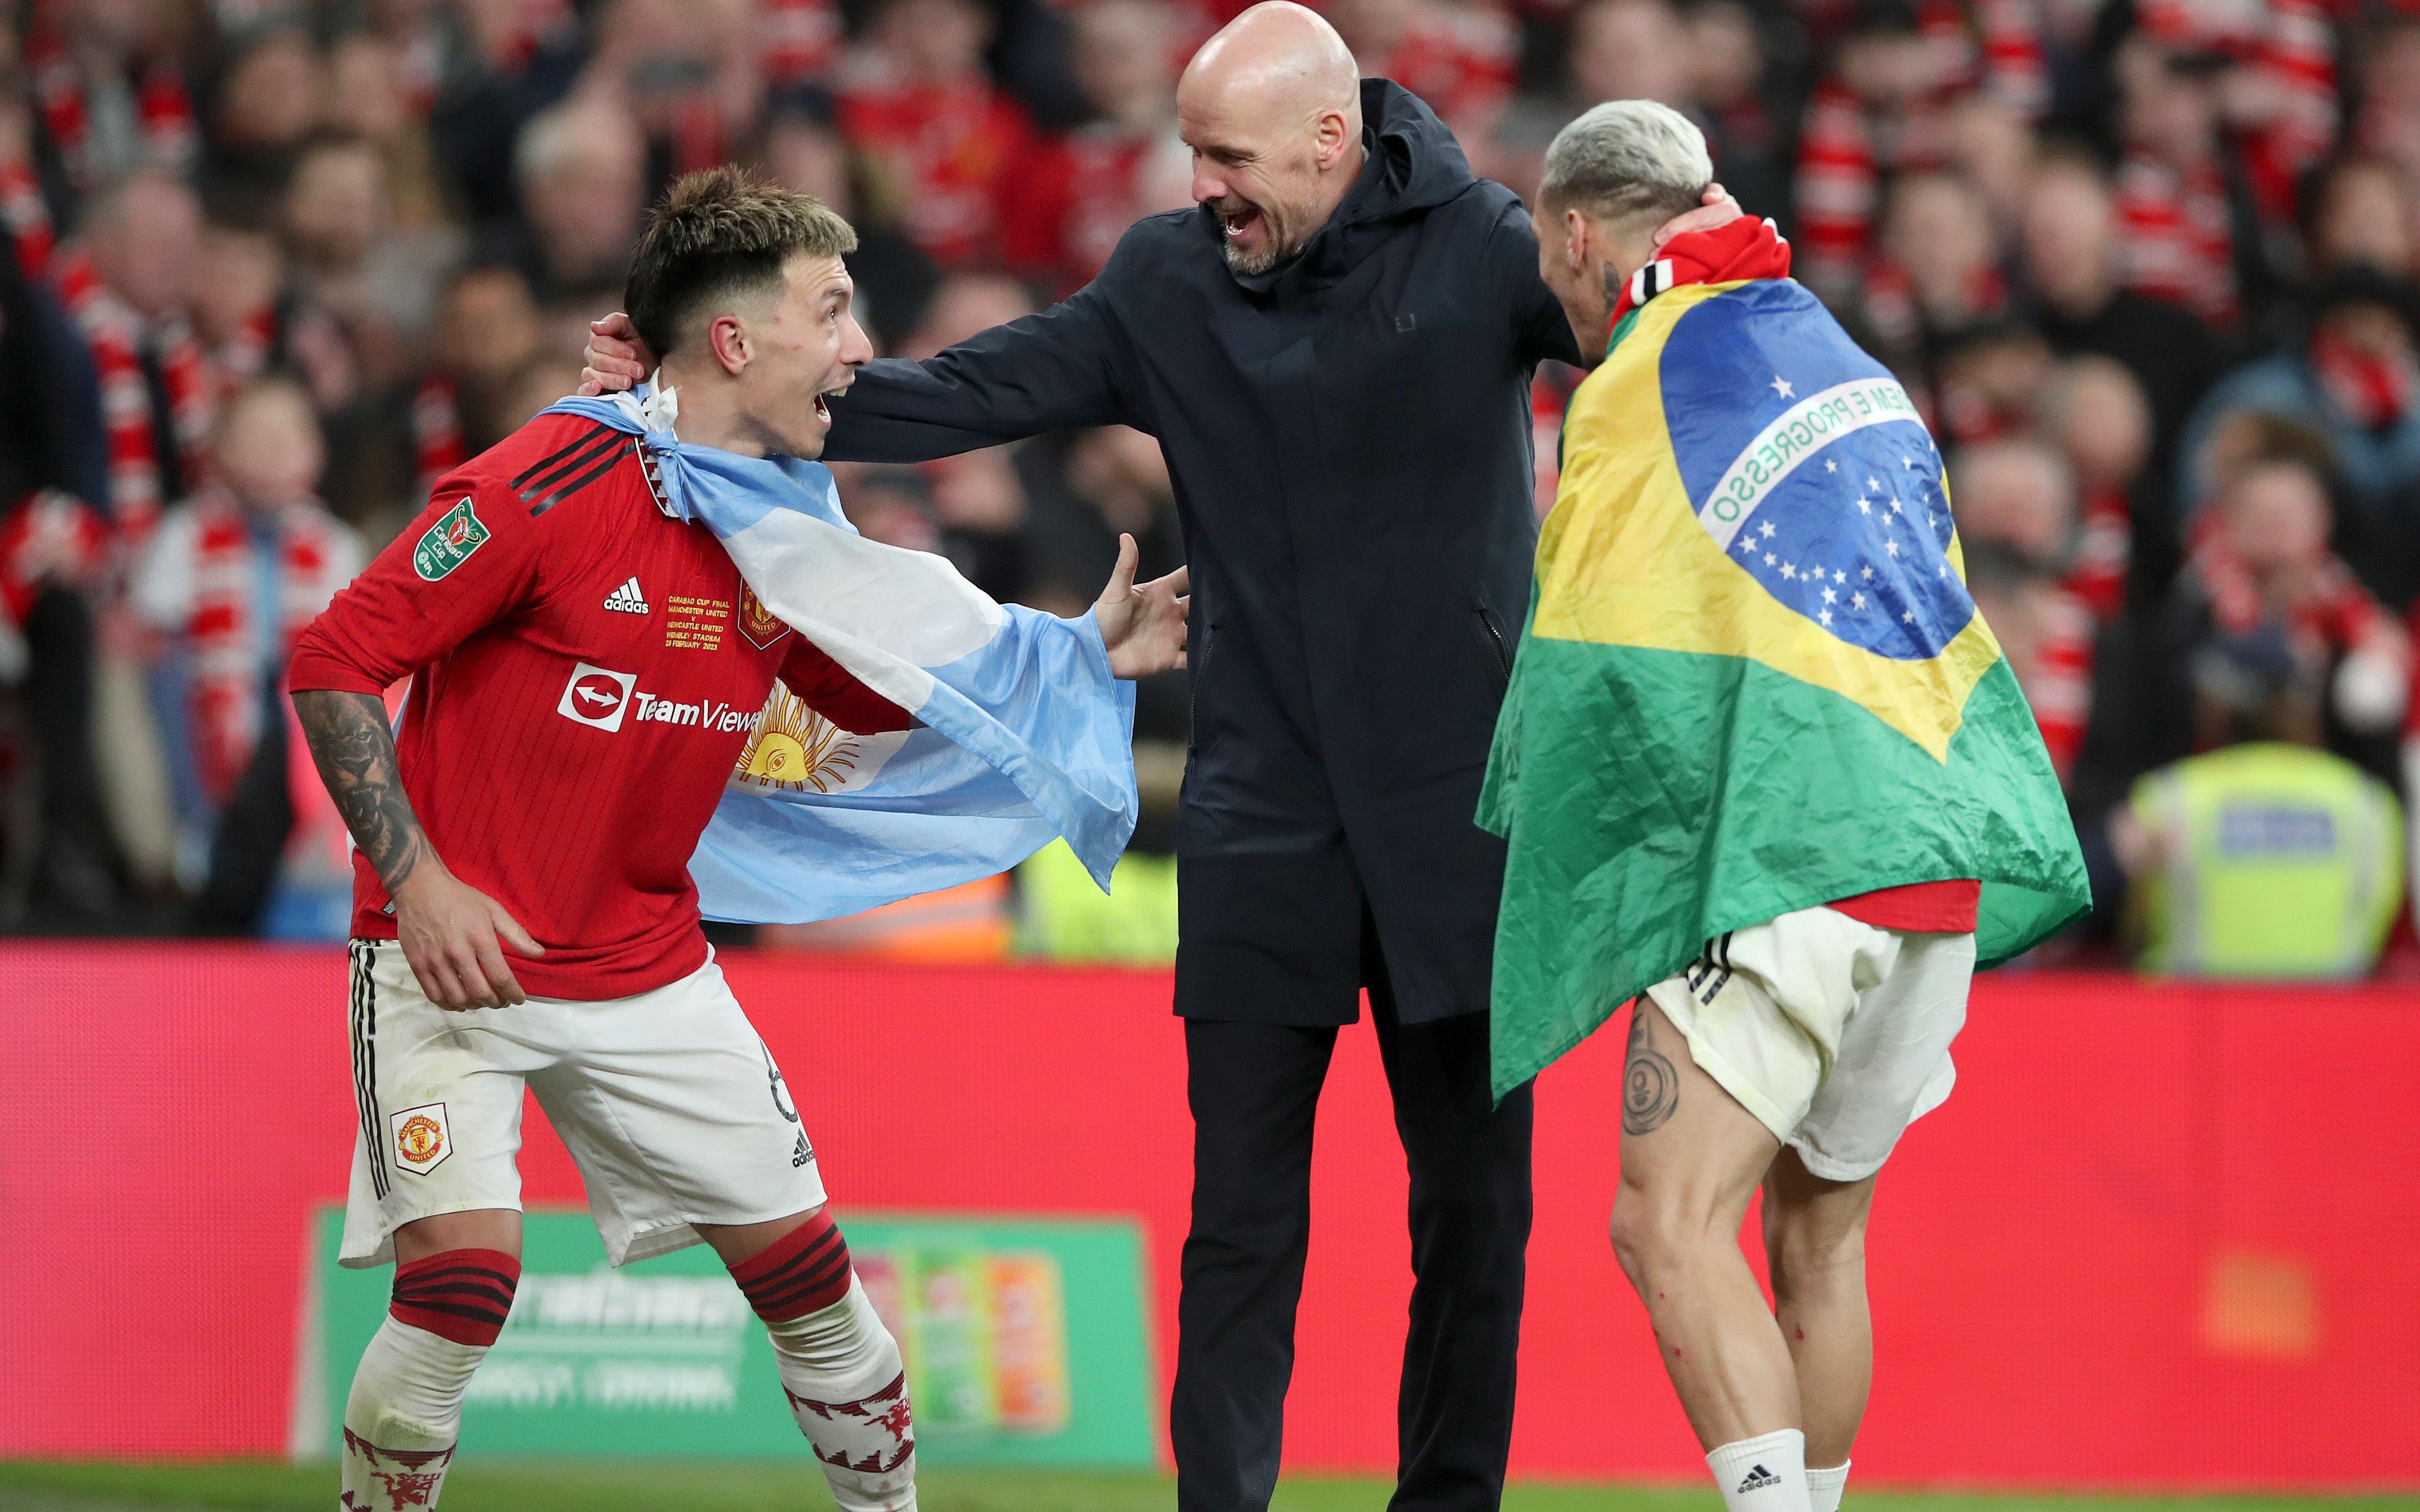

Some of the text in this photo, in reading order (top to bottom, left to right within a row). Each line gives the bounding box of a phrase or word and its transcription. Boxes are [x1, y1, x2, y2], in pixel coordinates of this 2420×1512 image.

[434, 526, 464, 559] Carabao
[432, 541, 446, 560] Cup
[604, 598, 649, 614] adidas
[669, 595, 695, 605] CARABAO
[668, 605, 728, 618] MANCHESTER UNITED
[667, 621, 724, 632] NEWCASTLE UNITED
[751, 620, 776, 632] UNITED
[693, 633, 721, 643] STADIUM
[672, 640, 701, 649] FEBRUARY
[401, 1117, 437, 1138] MANCHESTER
[409, 1149, 436, 1161] UNITED
[1738, 1475, 1781, 1493] adidas
